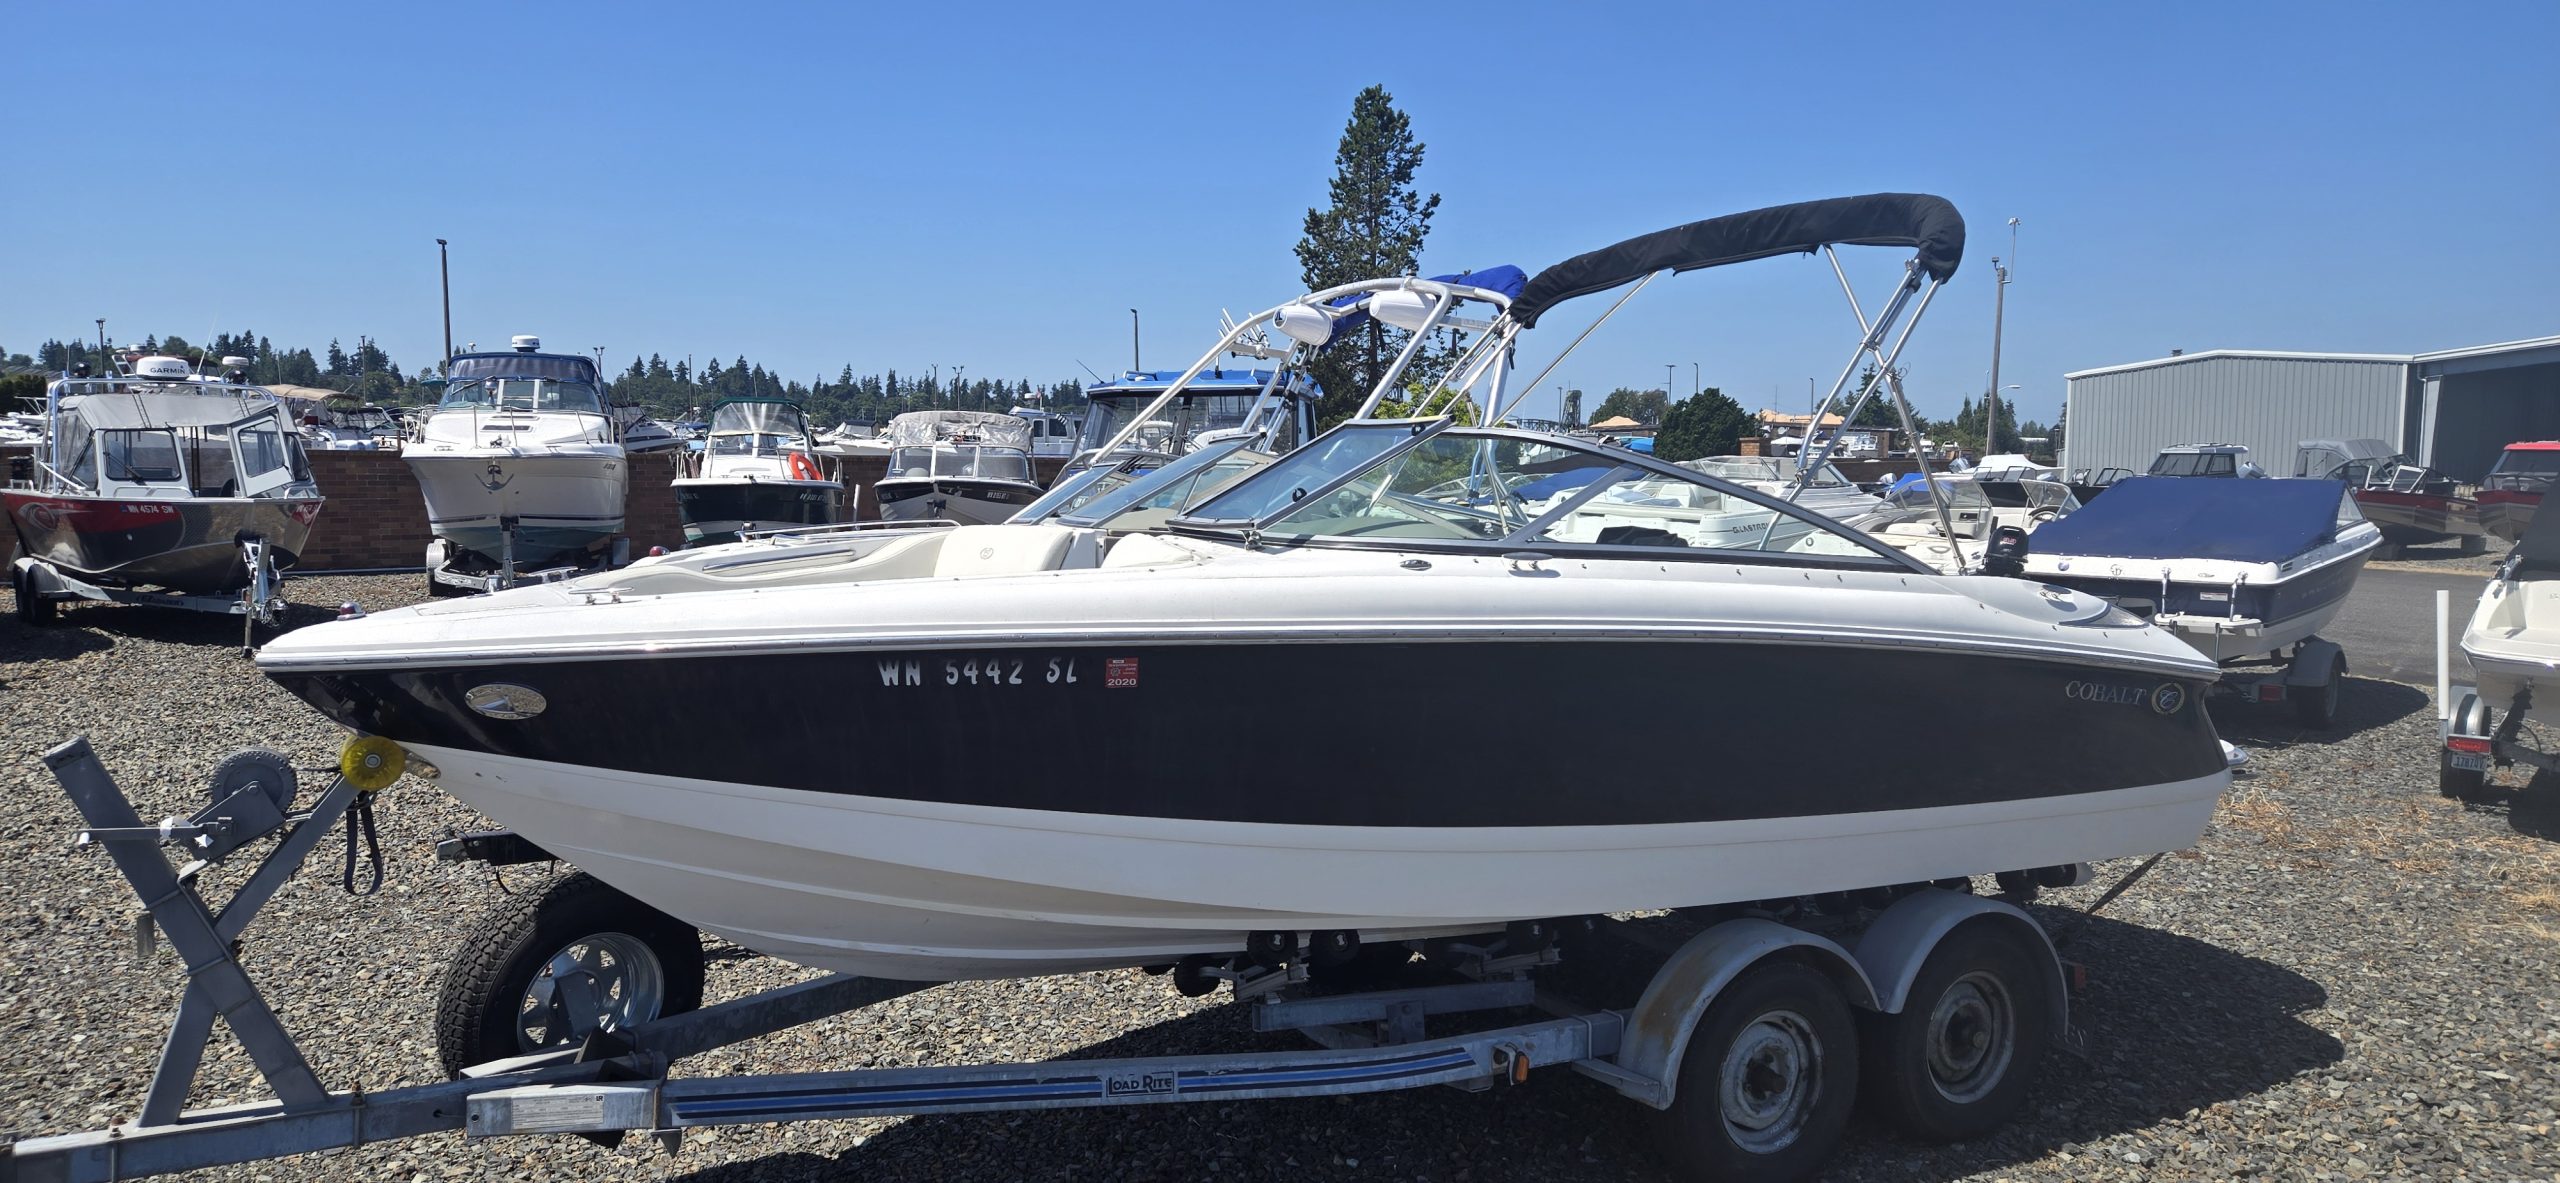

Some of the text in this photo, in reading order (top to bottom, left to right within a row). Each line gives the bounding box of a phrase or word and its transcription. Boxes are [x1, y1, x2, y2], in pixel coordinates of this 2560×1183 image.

[150, 367, 186, 375] GARMIN
[140, 504, 159, 513] 4574
[877, 656, 1077, 686] WN 5442 SL
[1107, 678, 1137, 686] 2020
[2065, 680, 2147, 706] COBALT
